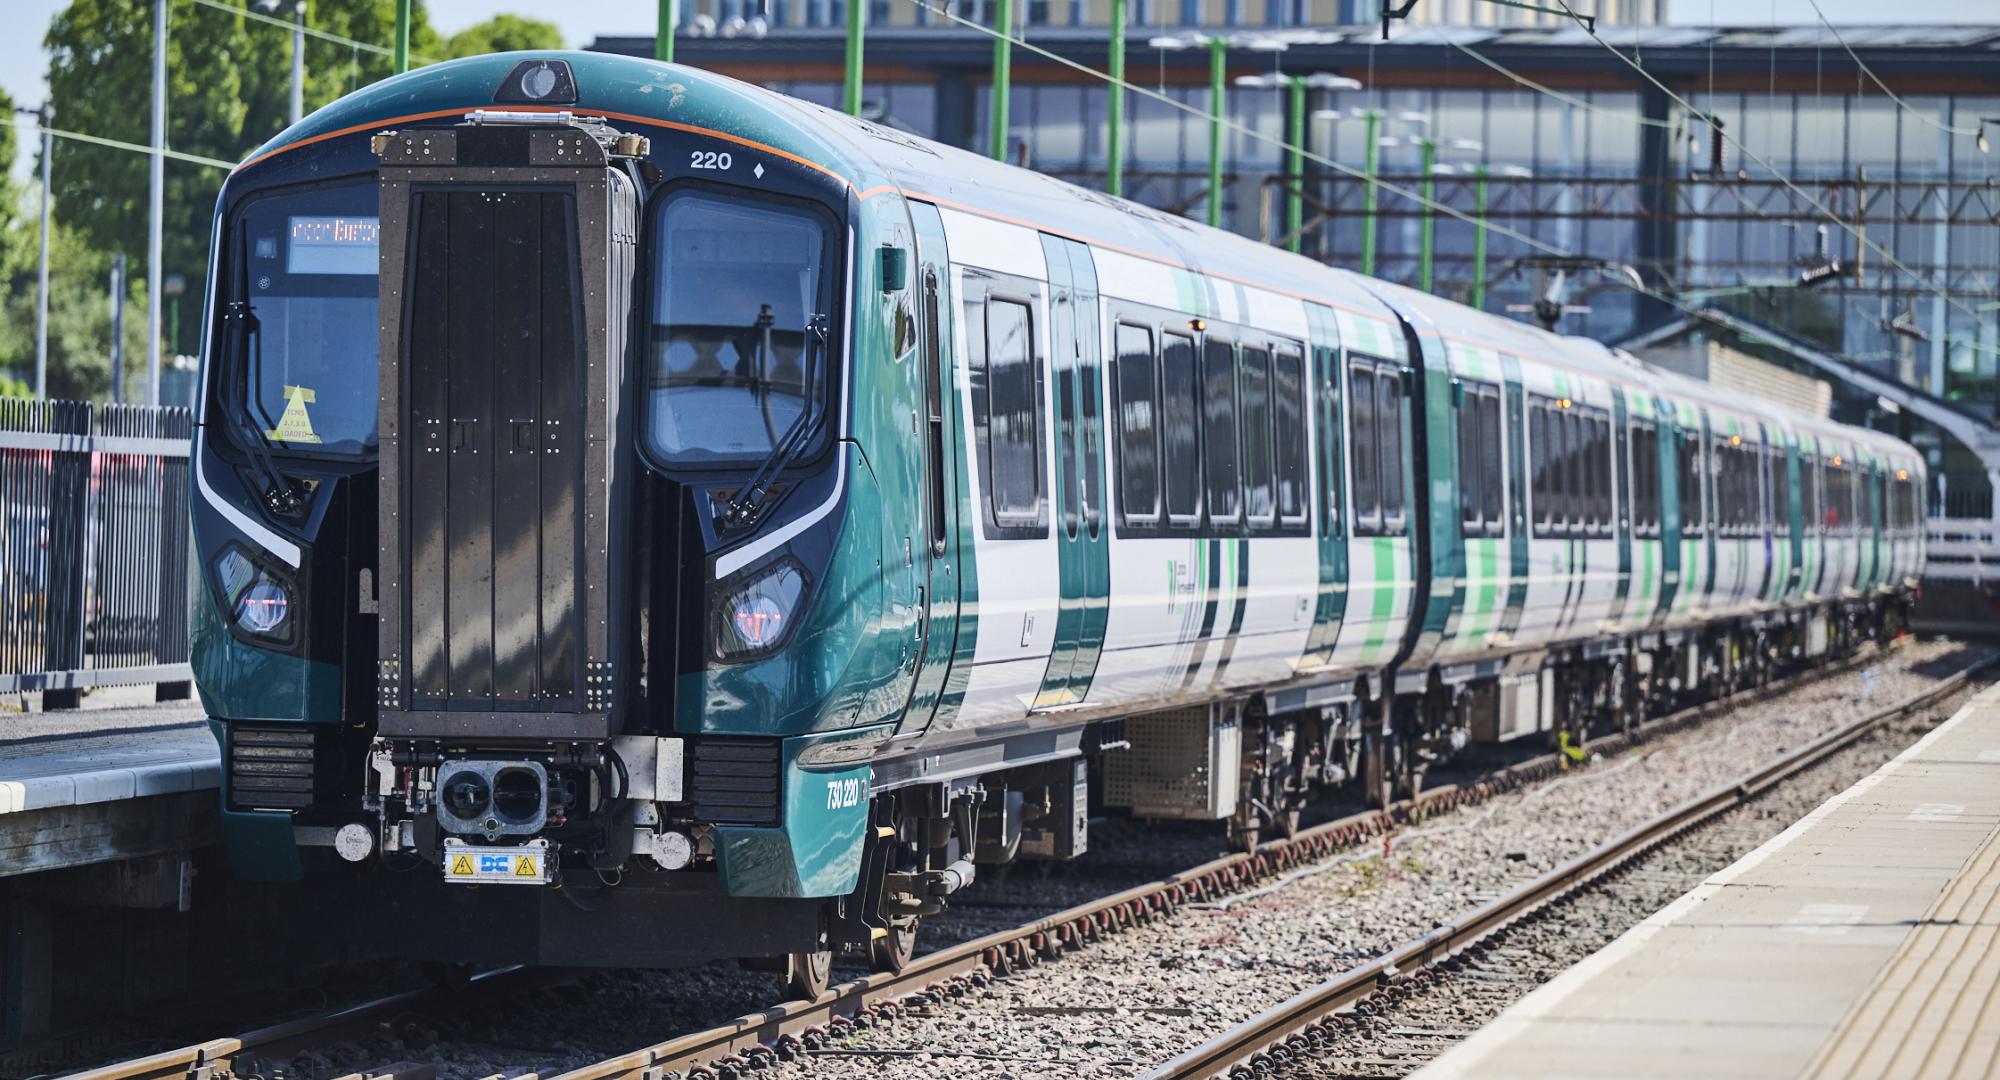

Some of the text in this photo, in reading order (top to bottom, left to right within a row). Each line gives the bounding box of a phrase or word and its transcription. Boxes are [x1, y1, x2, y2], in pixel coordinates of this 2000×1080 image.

[691, 151, 732, 170] 220
[281, 430, 307, 438] LOADED
[827, 778, 859, 810] 730 220
